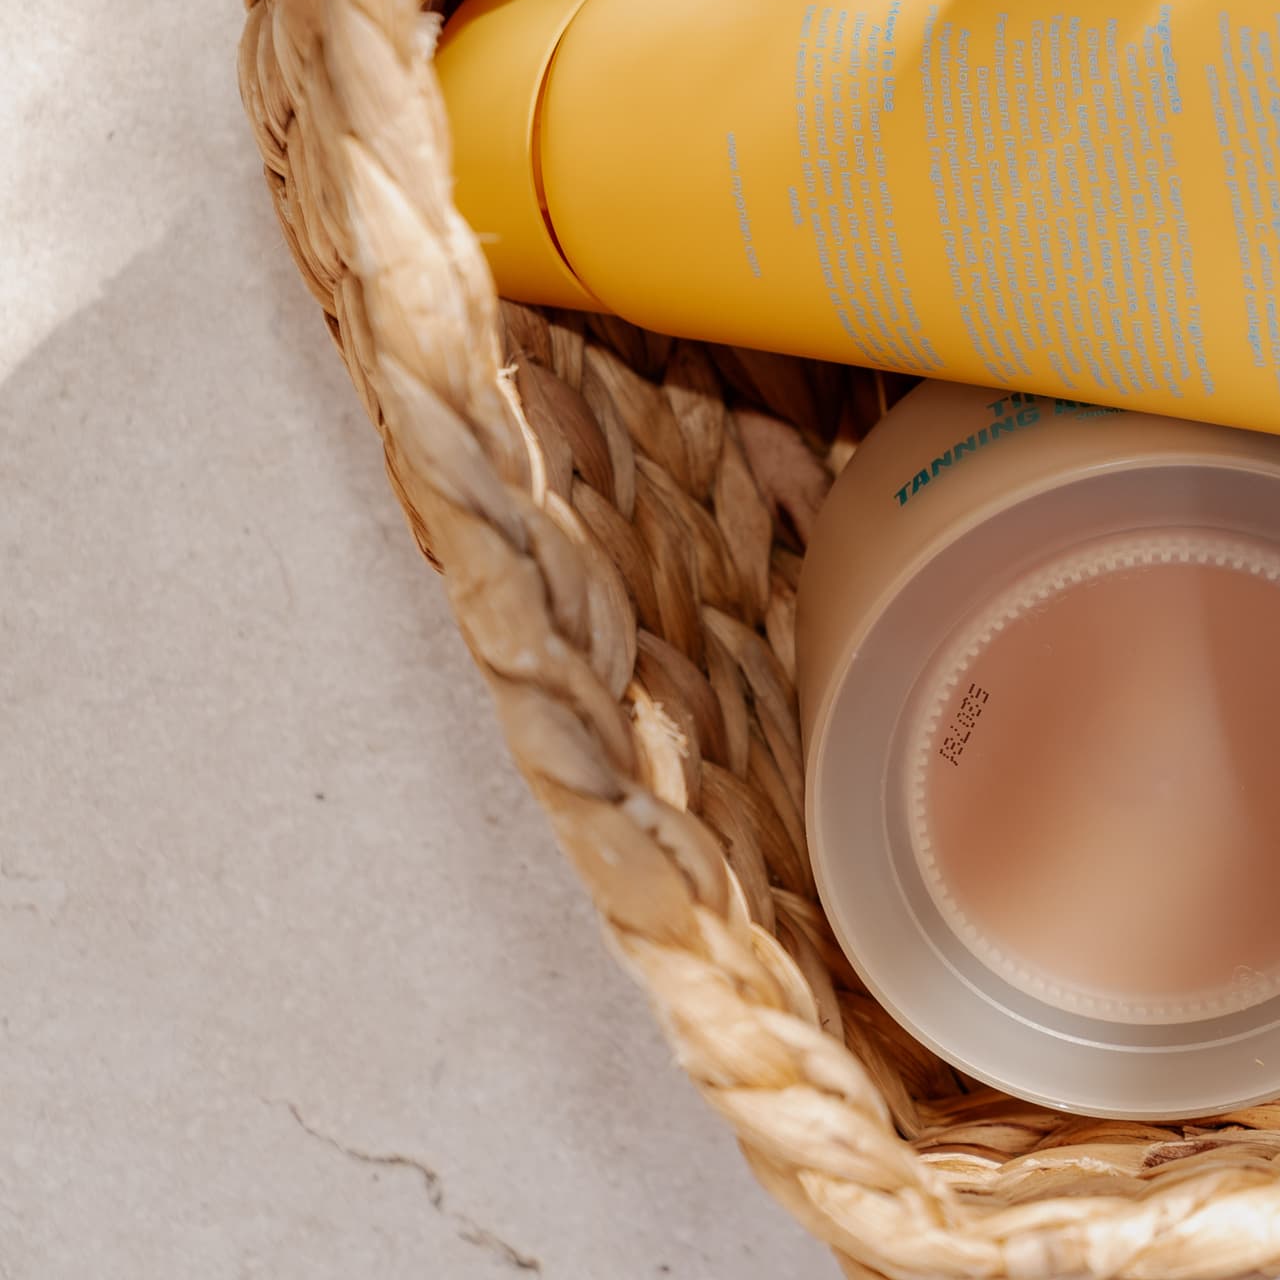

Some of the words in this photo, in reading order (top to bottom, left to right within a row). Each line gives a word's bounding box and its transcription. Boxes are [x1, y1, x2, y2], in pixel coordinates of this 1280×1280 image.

[883, 0, 901, 43] How
[881, 46, 896, 71] To
[1157, 4, 1182, 114] Ingredients
[881, 75, 895, 112] Use
[893, 407, 1041, 507] TANNING
